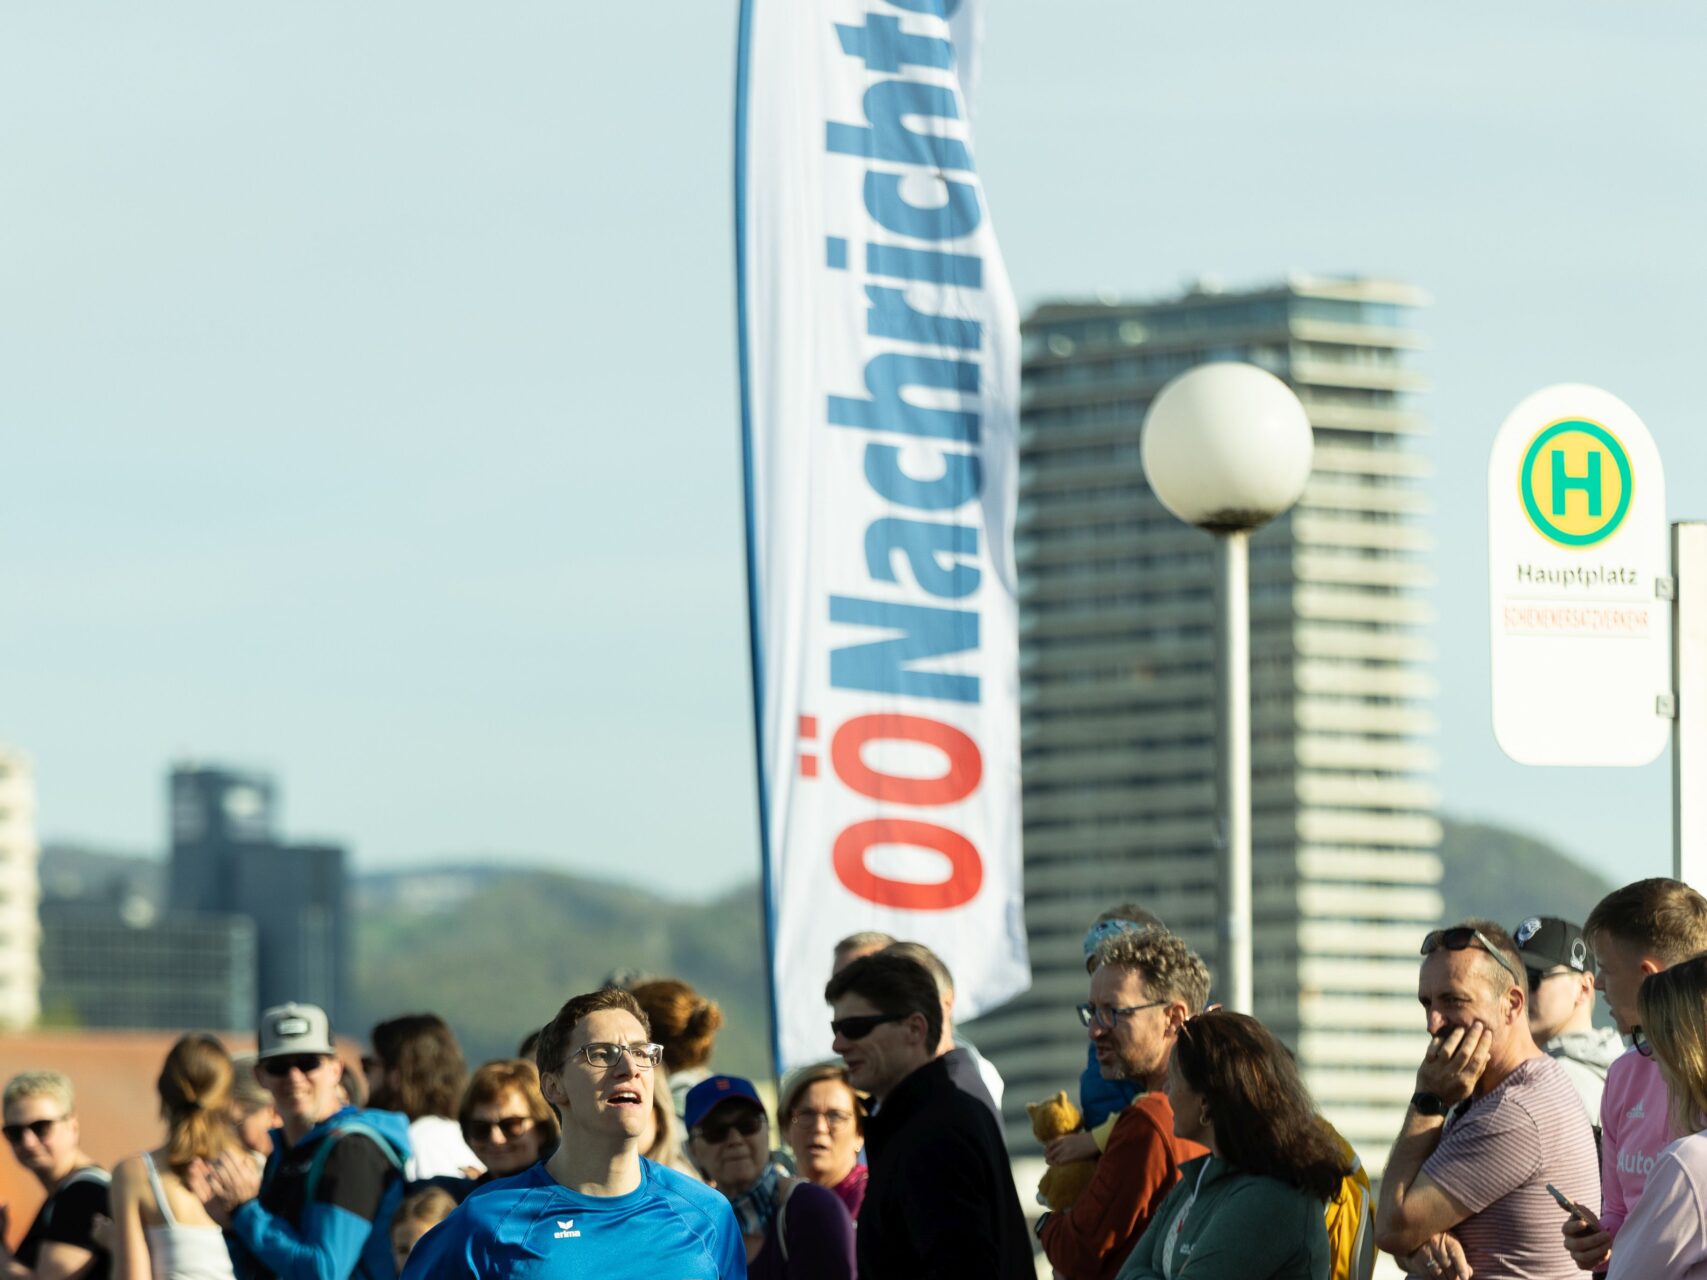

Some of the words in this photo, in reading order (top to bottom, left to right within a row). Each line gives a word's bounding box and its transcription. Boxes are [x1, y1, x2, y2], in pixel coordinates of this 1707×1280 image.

[797, 0, 984, 913] OÖNachricht
[1551, 450, 1602, 518] H
[1518, 563, 1638, 590] Hauptplatz
[553, 1230, 581, 1239] erima
